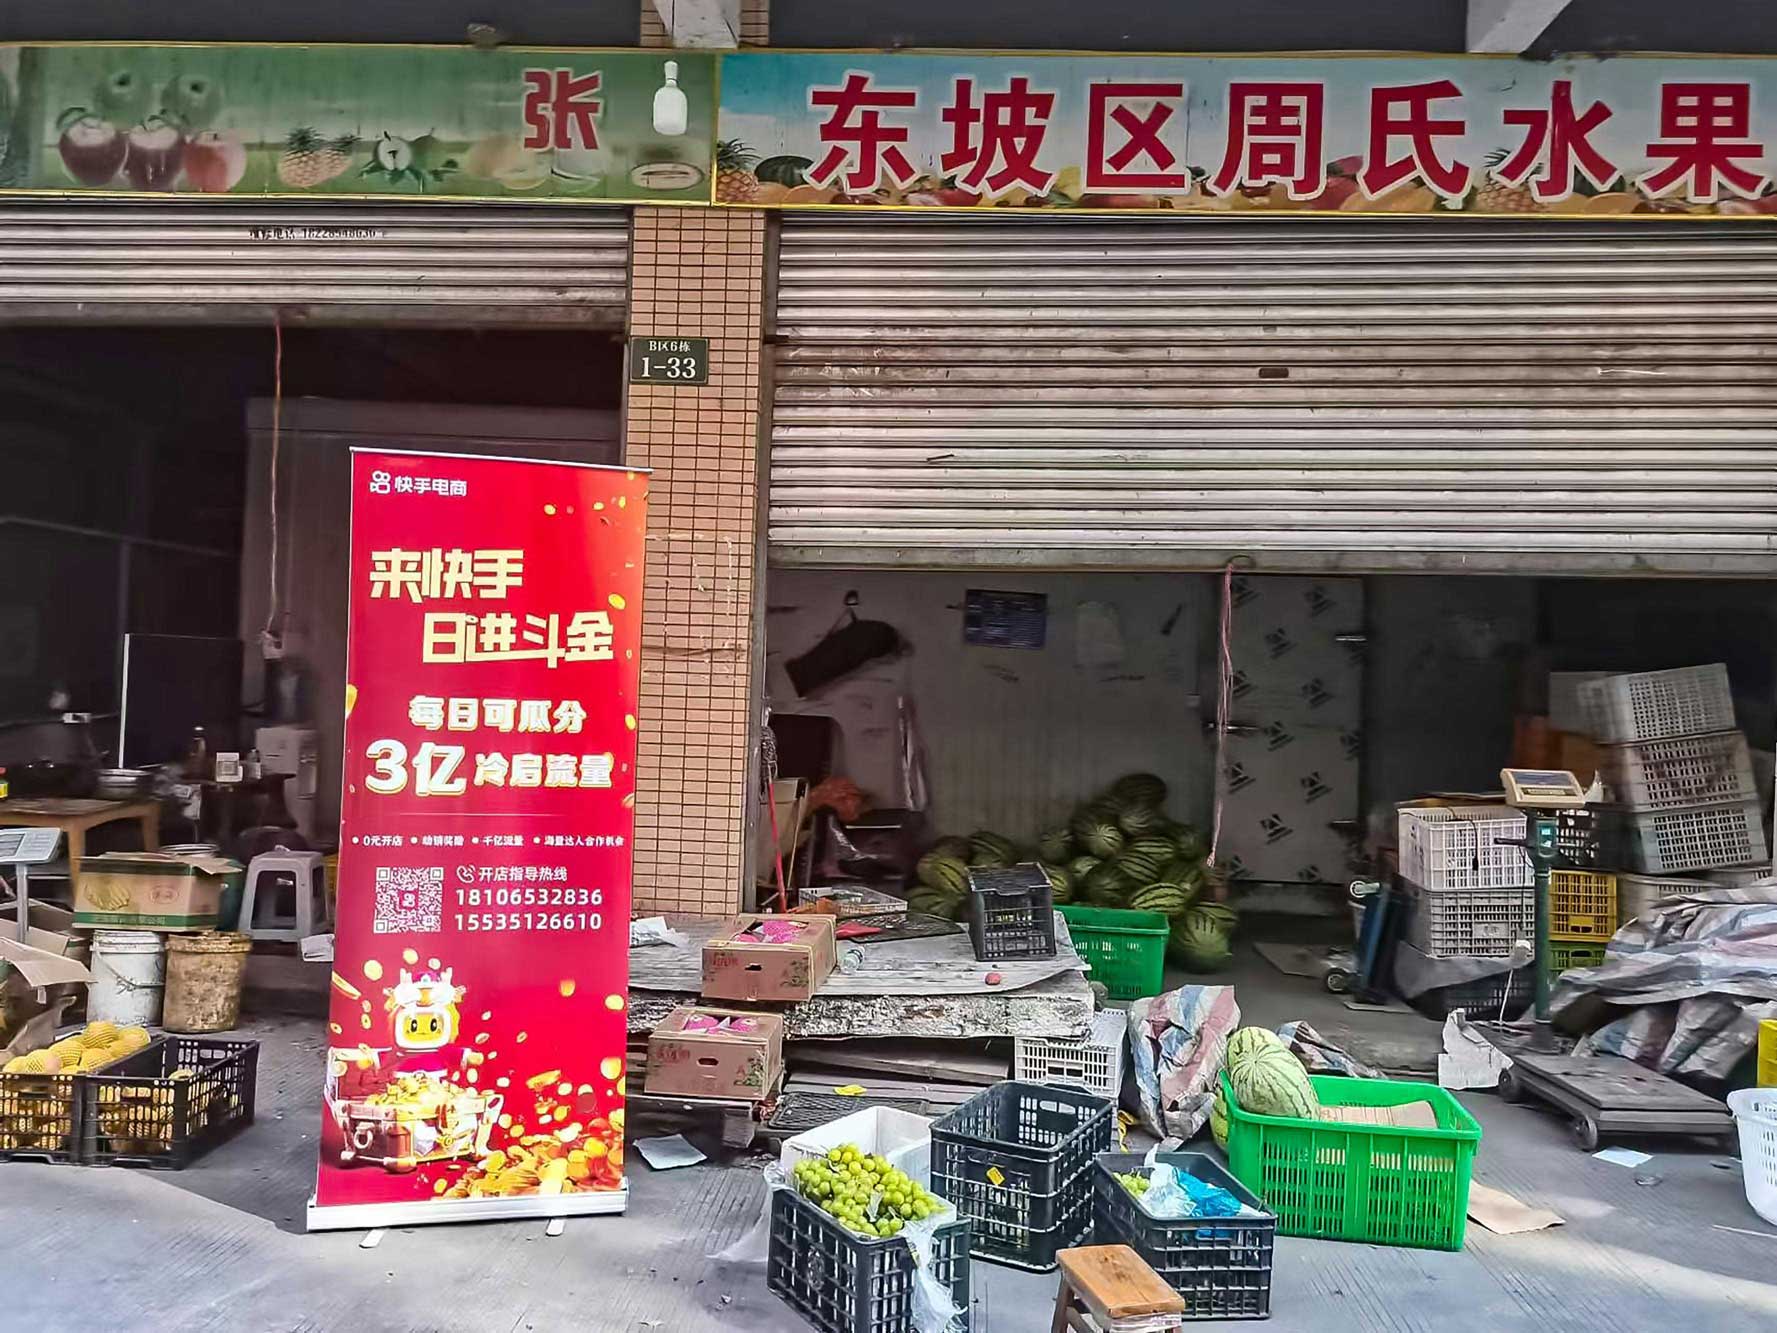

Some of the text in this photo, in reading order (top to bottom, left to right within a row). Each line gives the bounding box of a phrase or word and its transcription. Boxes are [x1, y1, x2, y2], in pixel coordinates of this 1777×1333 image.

[524, 71, 600, 149] 张
[809, 75, 1767, 197] 东坡区周氏水果
[649, 340, 691, 352] B区6栋
[641, 357, 696, 378] 1-33
[394, 475, 467, 497] 快手电商
[369, 547, 524, 604] 来快手
[422, 611, 614, 669] 日进斗金
[408, 694, 587, 734] 每日可瓜分
[363, 834, 403, 847] 0元开店
[483, 834, 524, 847] 千亿流量
[478, 865, 568, 883] 开店指导热线
[455, 887, 603, 906] 18106532836
[454, 912, 602, 931] 15535126610
